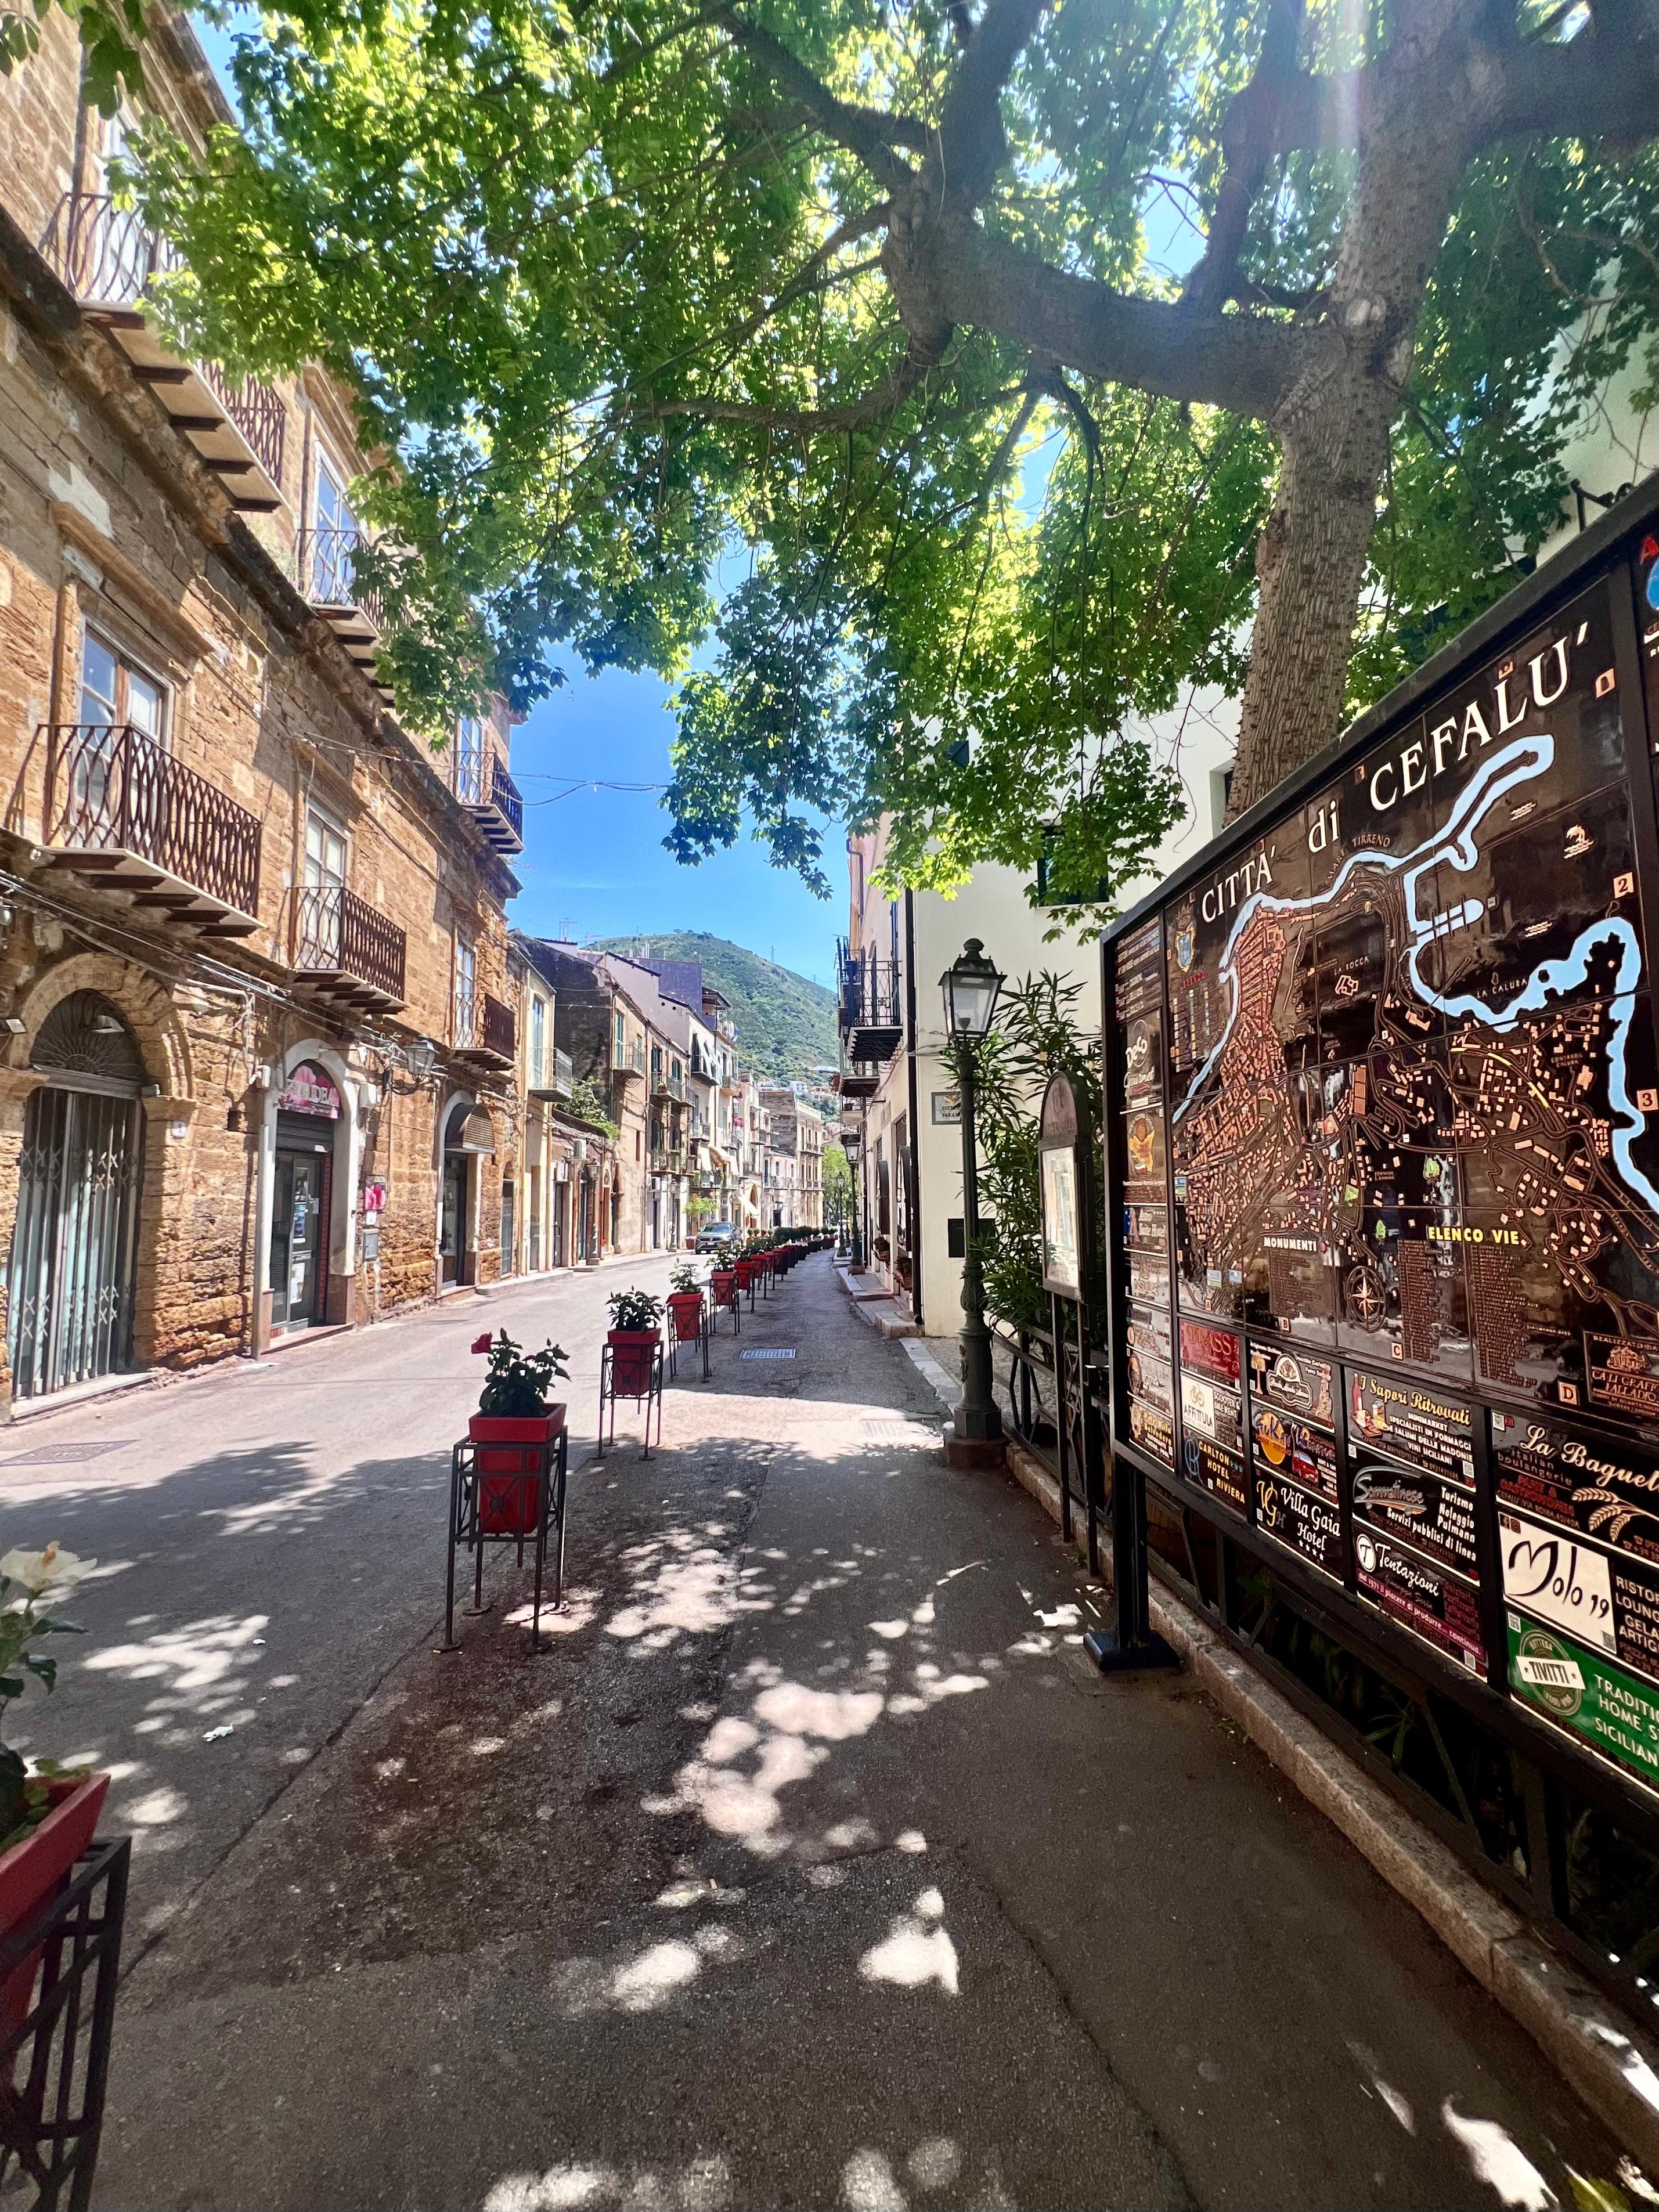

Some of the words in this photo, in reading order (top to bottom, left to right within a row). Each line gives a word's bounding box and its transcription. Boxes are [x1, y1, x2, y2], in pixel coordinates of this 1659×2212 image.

[1202, 845, 1276, 922] CITTA'
[1308, 800, 1340, 853] di
[1371, 622, 1588, 811] CEFALU'
[1352, 833, 1390, 847] TIRRENO
[1619, 878, 1628, 893] 2
[1477, 990, 1487, 998] LA
[1492, 979, 1527, 994] CALURA
[1642, 1092, 1653, 1107] 3
[1264, 1237, 1317, 1252] MONUMENTI
[1428, 1226, 1483, 1243] ELENCO
[1492, 1230, 1520, 1245] VIE
[1187, 1325, 1231, 1355] BRASS
[1593, 1336, 1643, 1349] REALIZZATO
[1224, 1406, 1237, 1419] RENT
[1370, 1379, 1408, 1403] Sapori
[1410, 1392, 1471, 1426] Ritrovati
[1389, 1416, 1423, 1434] SPECIALISTI
[1425, 1428, 1433, 1437] IN
[1435, 1432, 1472, 1451] FORMAGGI
[1408, 1412, 1448, 1432] MINIMARKET
[1199, 1441, 1229, 1466] CARLTON
[1394, 1427, 1416, 1441] SALUMI
[1418, 1436, 1438, 1450] DELLE
[1440, 1444, 1473, 1463] MADONIE
[1408, 1441, 1421, 1453] VINI
[1423, 1448, 1452, 1465] SICILIANI
[1519, 1425, 1556, 1456] La
[1207, 1458, 1229, 1480] HOTEL
[1498, 1452, 1573, 1486] boulangerie
[1217, 1478, 1245, 1503] RIVIERA
[1441, 1486, 1473, 1511] Turismo
[1500, 1478, 1575, 1516] GASTRONOMIA
[1281, 1488, 1308, 1518] Villa
[1311, 1506, 1341, 1537] Gaia
[1439, 1502, 1474, 1529] Noleggio
[1297, 1522, 1328, 1551] Hotel
[1387, 1507, 1411, 1528] Servizi
[1412, 1520, 1444, 1544] pubblici
[1445, 1536, 1454, 1550] di
[1455, 1539, 1476, 1561] linea
[1437, 1515, 1475, 1543] Pulmann
[1375, 1543, 1439, 1596] Tentazioni
[1505, 1540, 1584, 1606] Molo
[1589, 1594, 1610, 1619] 19
[1385, 1588, 1406, 1606] piacere
[1407, 1601, 1413, 1611] di
[1529, 1661, 1570, 1684] TIVITTI
[1599, 1694, 1642, 1732] HOME
[1595, 1717, 1658, 1767] SICILIAN
